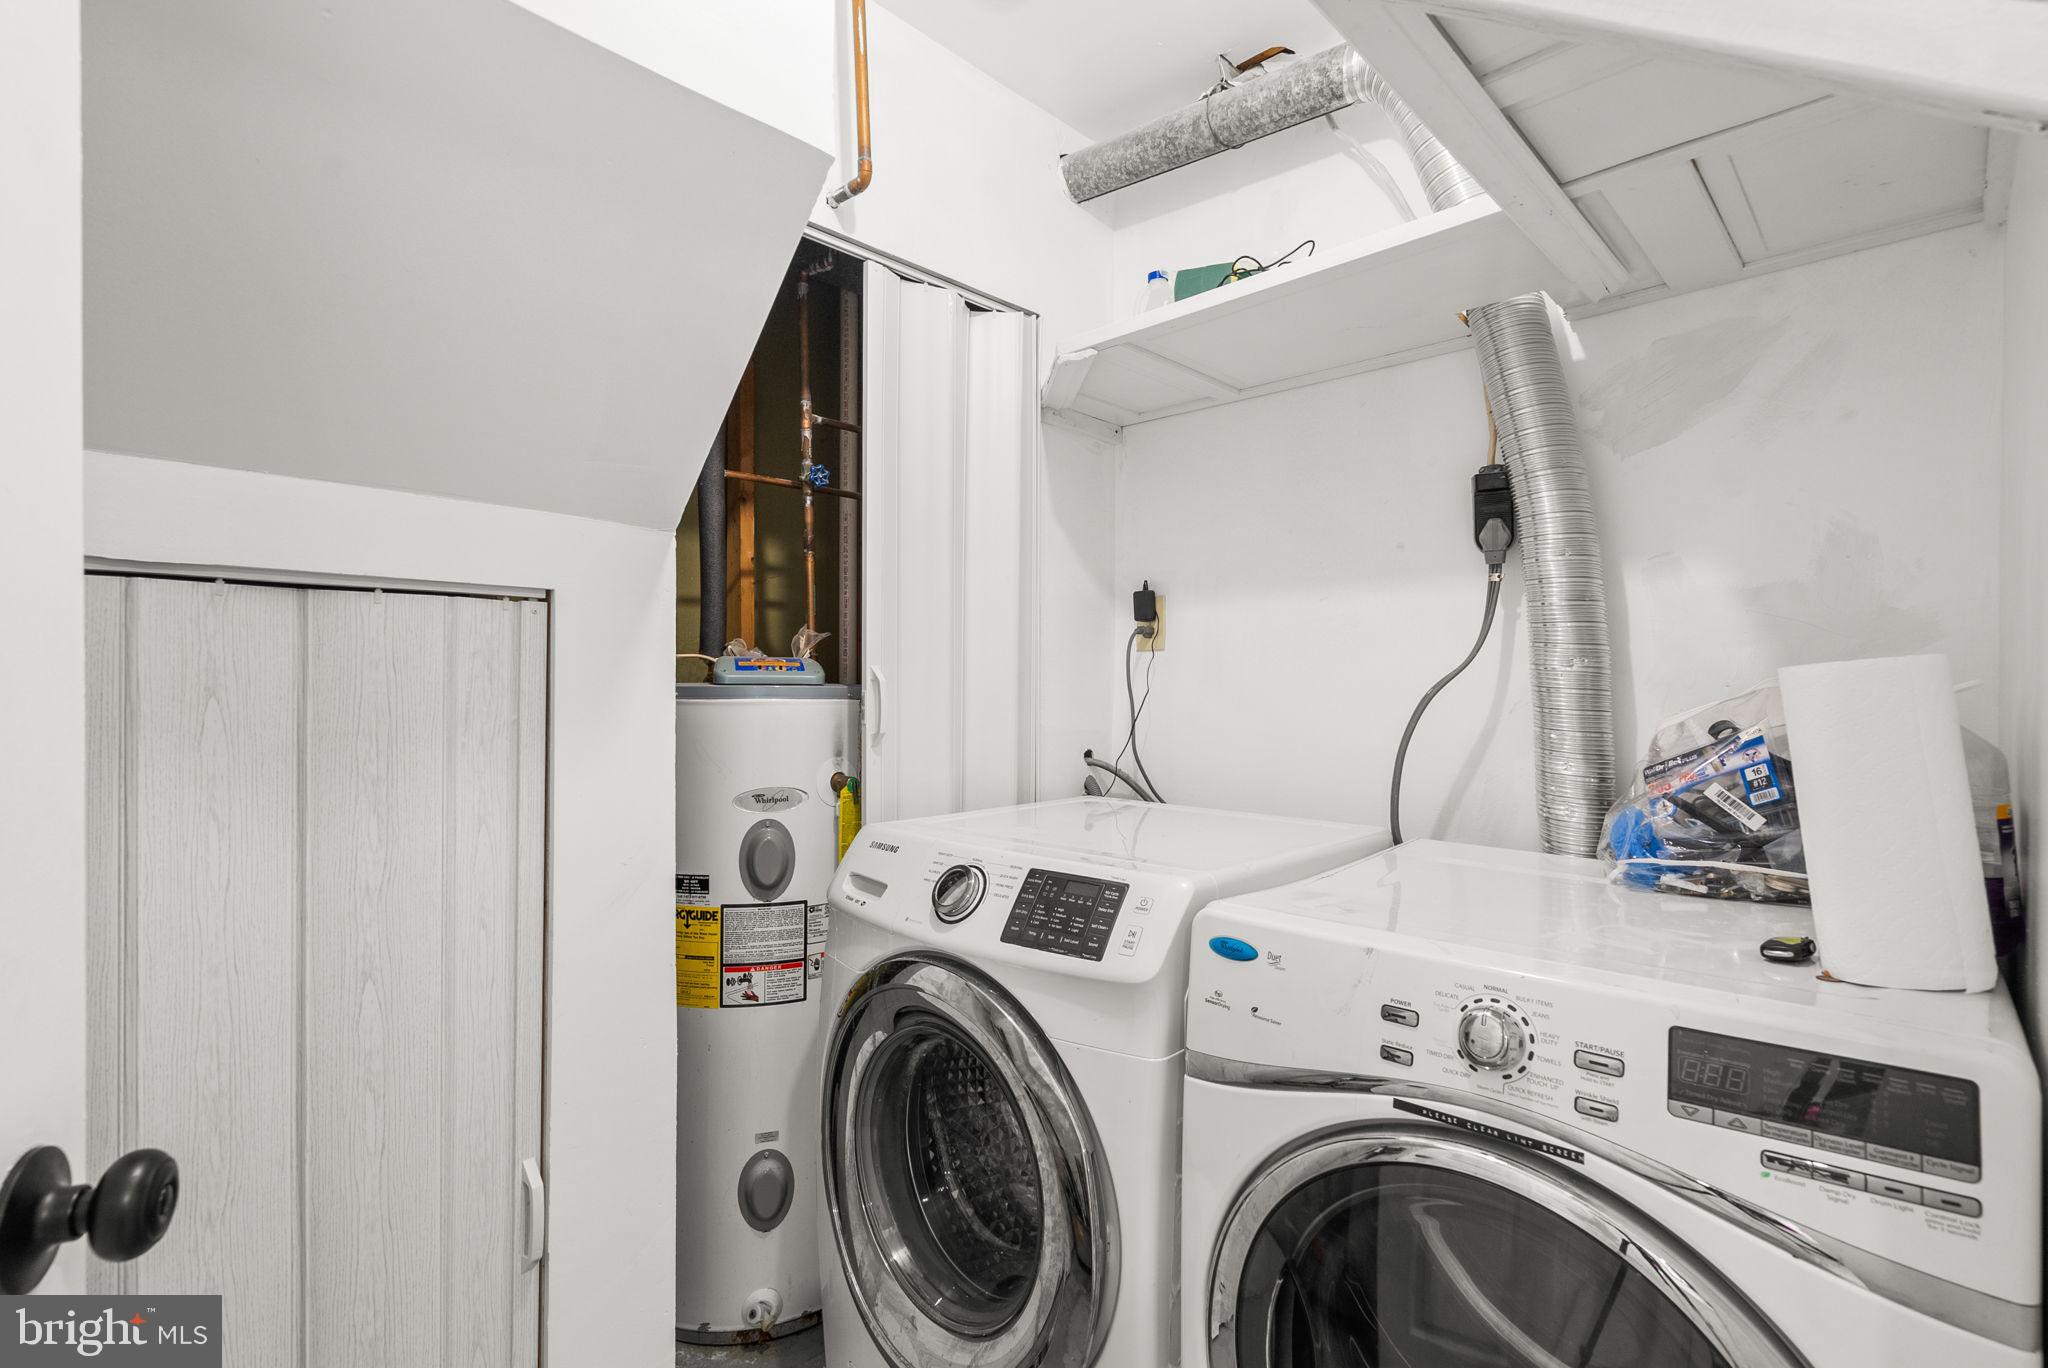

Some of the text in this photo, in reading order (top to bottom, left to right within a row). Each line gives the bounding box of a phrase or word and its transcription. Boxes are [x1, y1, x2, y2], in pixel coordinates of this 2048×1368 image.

[1751, 766, 1763, 776] 16
[1752, 777, 1767, 787] #12
[753, 794, 789, 805] Whirlpool
[869, 841, 900, 853] SAMSUNG
[1267, 951, 1281, 962] Duet
[1454, 983, 1475, 992] CASUAL
[1483, 984, 1509, 994] NORMAL
[1435, 990, 1459, 1000] DELICATE
[1390, 998, 1412, 1008] POWER
[1515, 995, 1554, 1008] BULKY ITEMS
[1532, 1011, 1550, 1020] JEANS
[1540, 1031, 1561, 1040] HEAVY
[1540, 1038, 1558, 1047] DUTY
[1426, 1049, 1442, 1058] TIMED
[1574, 1041, 1625, 1058] START/PAUSE
[1536, 1055, 1562, 1067] TOWELS
[1441, 1067, 1472, 1079] QUICK DRY
[1526, 1077, 1548, 1088] TOUCH
[1529, 1073, 1564, 1085] ENHANCED
[1507, 1085, 1526, 1095] QUICK
[1527, 1089, 1554, 1101] REFRESH
[1575, 1089, 1620, 1105] Wrinkle Shield
[1422, 1109, 1458, 1124] PLEASE
[1506, 1133, 1533, 1147] LINT
[1542, 1144, 1585, 1161] SCREEN
[1763, 1122, 1808, 1138] Temperature
[1814, 1134, 1842, 1147] Dryness
[1925, 1158, 1948, 1169] Cycle
[1818, 1184, 1857, 1201] Damp Dry
[1869, 1197, 1915, 1214] Drum Light
[1924, 1210, 1958, 1223] Control
